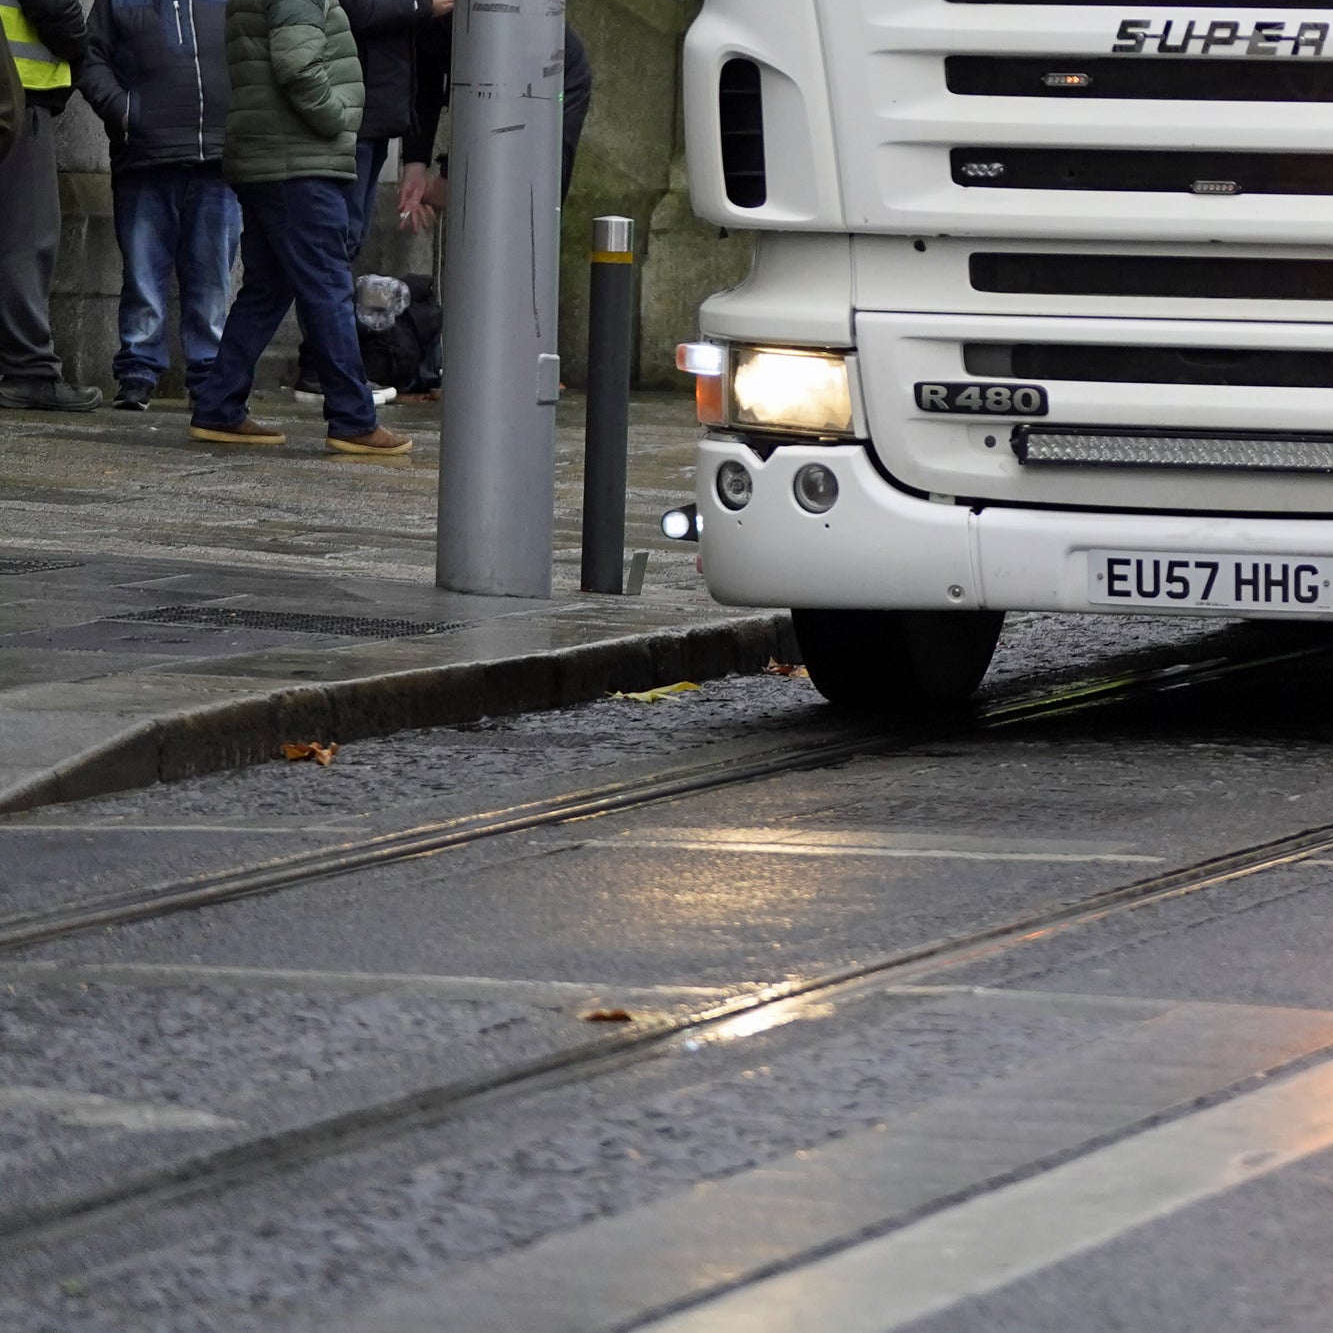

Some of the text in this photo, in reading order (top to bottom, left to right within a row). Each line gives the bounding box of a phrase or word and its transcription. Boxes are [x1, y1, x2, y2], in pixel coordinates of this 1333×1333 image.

[1111, 19, 1331, 57] SUPER
[921, 384, 1041, 413] R 480
[1106, 557, 1320, 605] EU57 HHG
